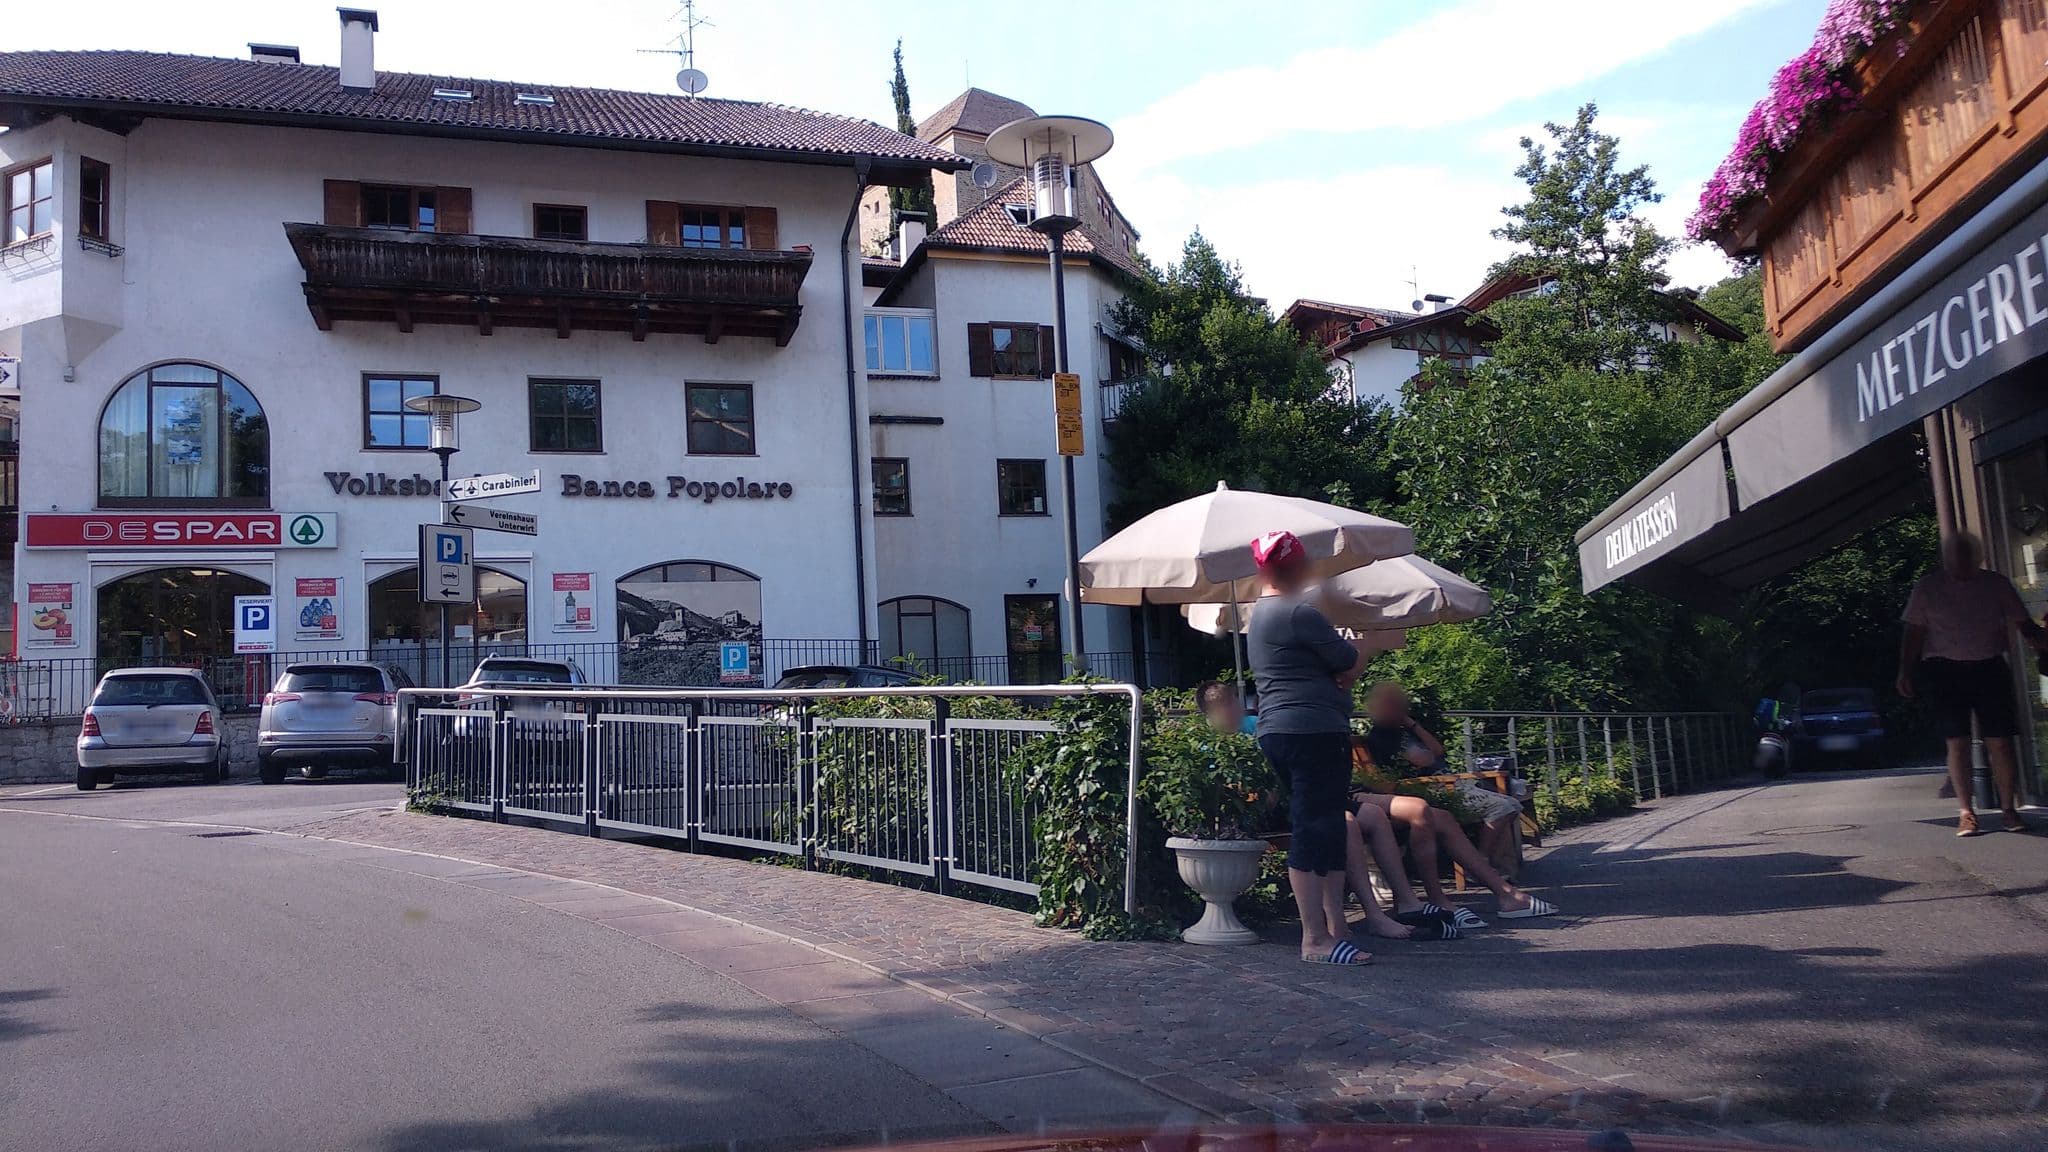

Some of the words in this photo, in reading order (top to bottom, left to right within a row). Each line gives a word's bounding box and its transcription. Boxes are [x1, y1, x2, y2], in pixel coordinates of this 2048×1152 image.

[482, 475, 537, 491] Carabinieri
[561, 474, 655, 498] Banca
[667, 476, 793, 503] Popolare
[490, 510, 535, 523] Vereinshaus
[83, 521, 276, 540] DESPAR
[498, 521, 535, 533] Unterwirt
[1605, 491, 1678, 570] DELIKATESSEN
[443, 537, 456, 559] P
[247, 607, 265, 628] P
[729, 648, 741, 667] P
